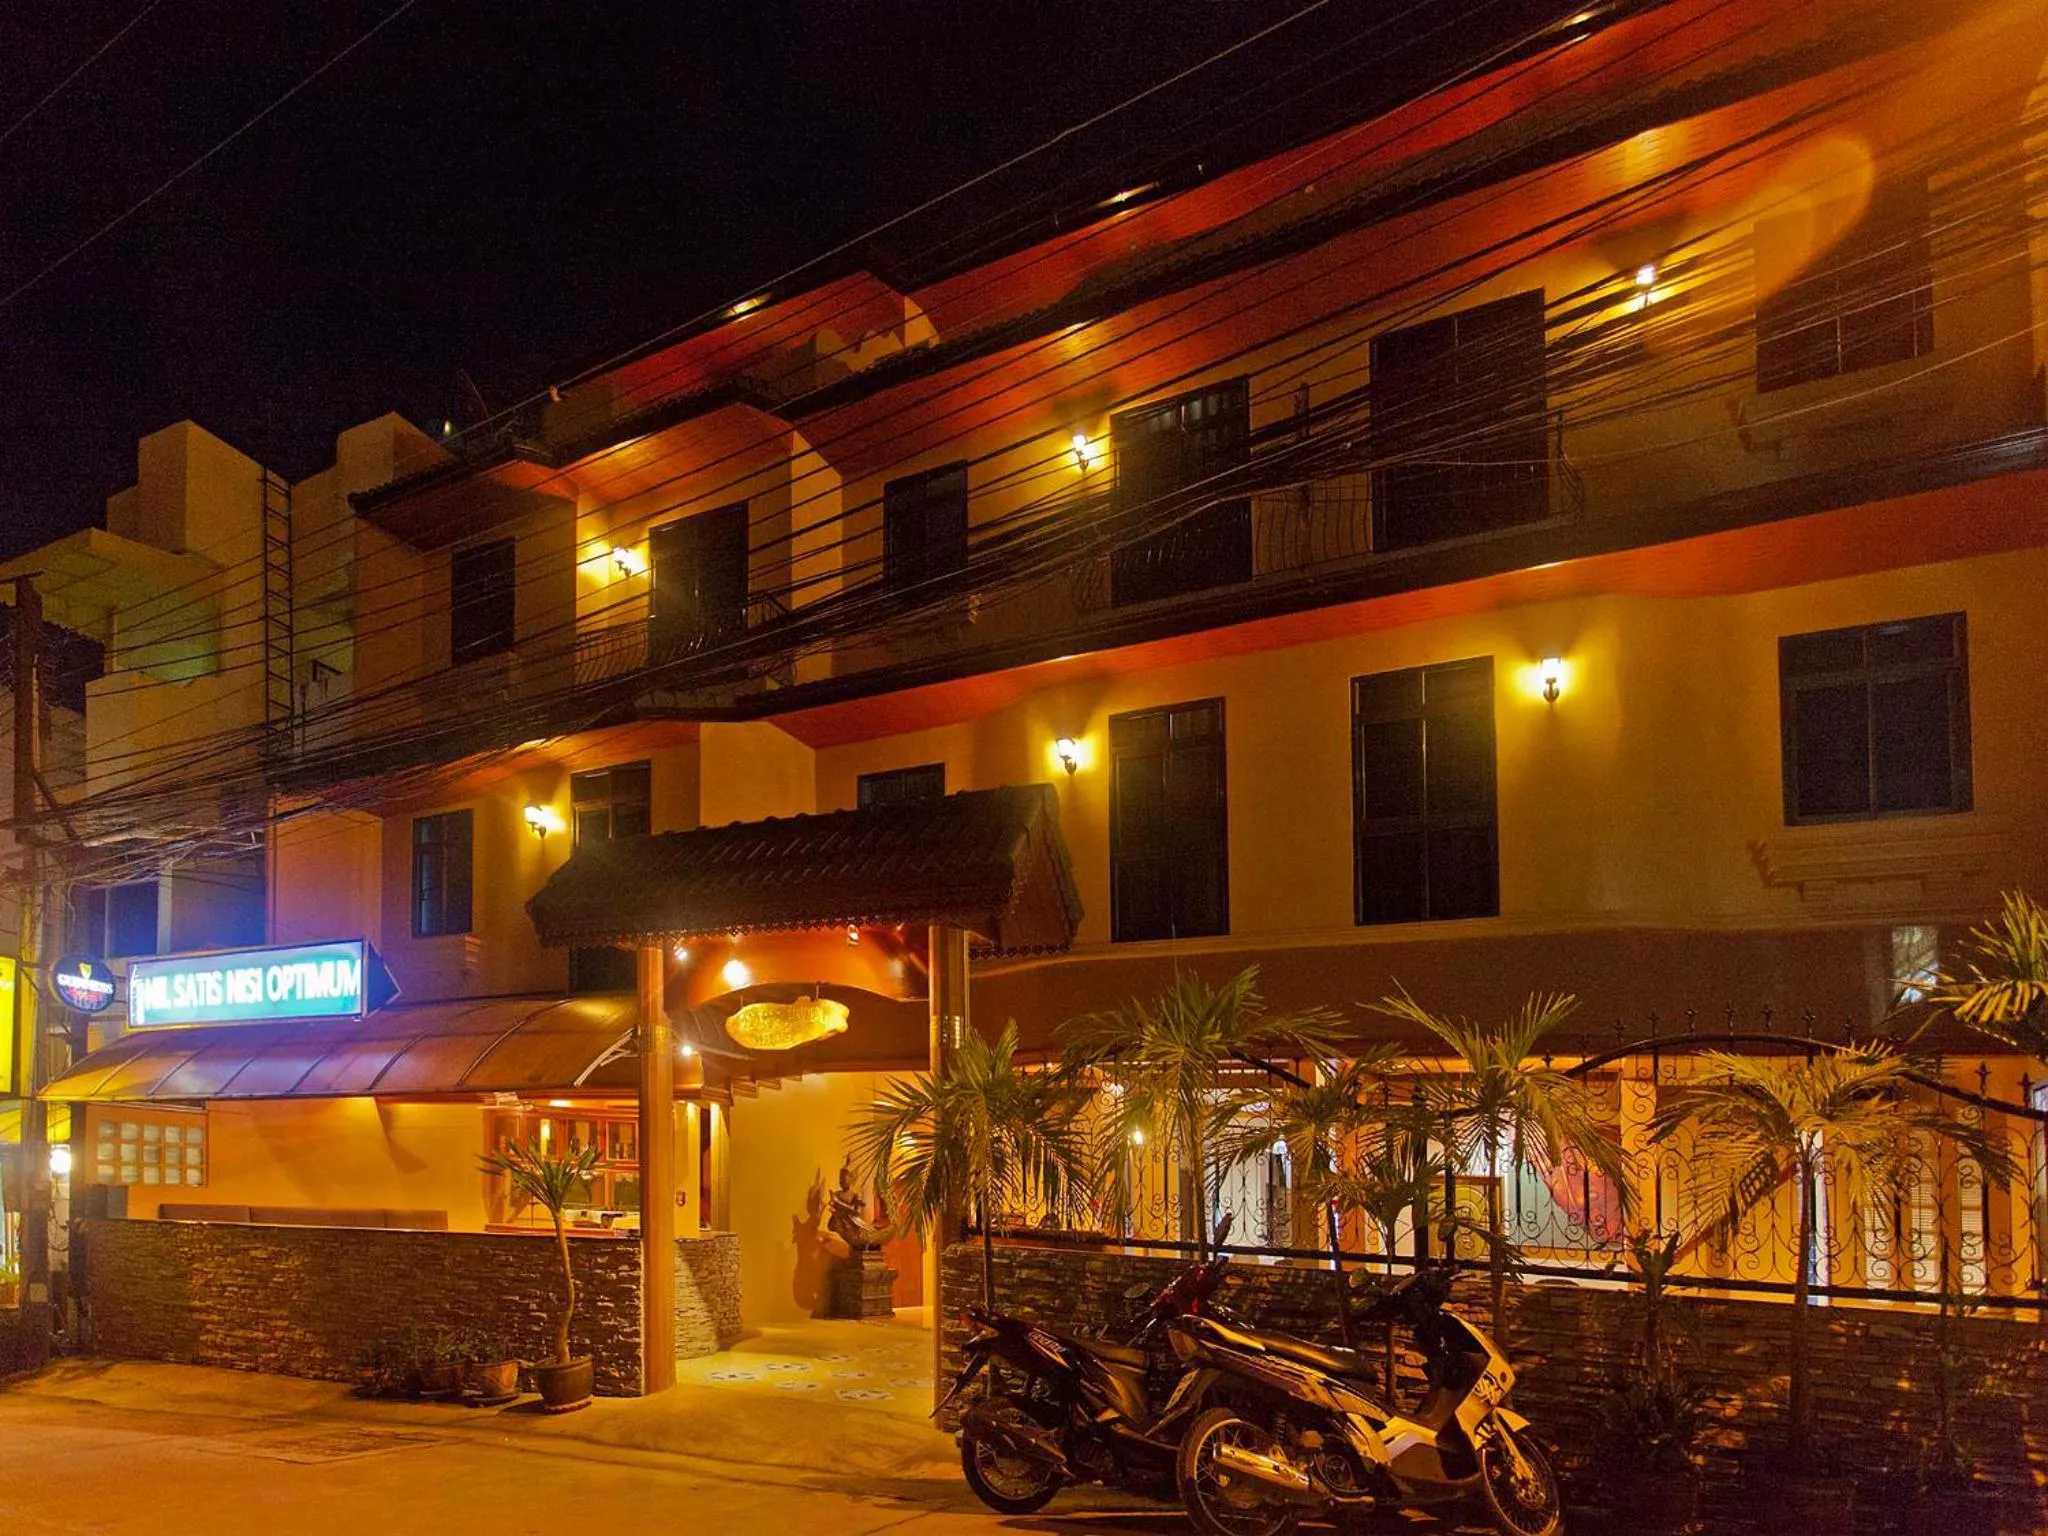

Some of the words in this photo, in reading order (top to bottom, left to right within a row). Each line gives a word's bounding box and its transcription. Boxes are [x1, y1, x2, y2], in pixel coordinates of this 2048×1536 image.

[144, 976, 170, 1008] NIL
[173, 971, 221, 1006] SATIS
[226, 968, 263, 1004] NISI
[267, 959, 361, 1001] OPTIMUM
